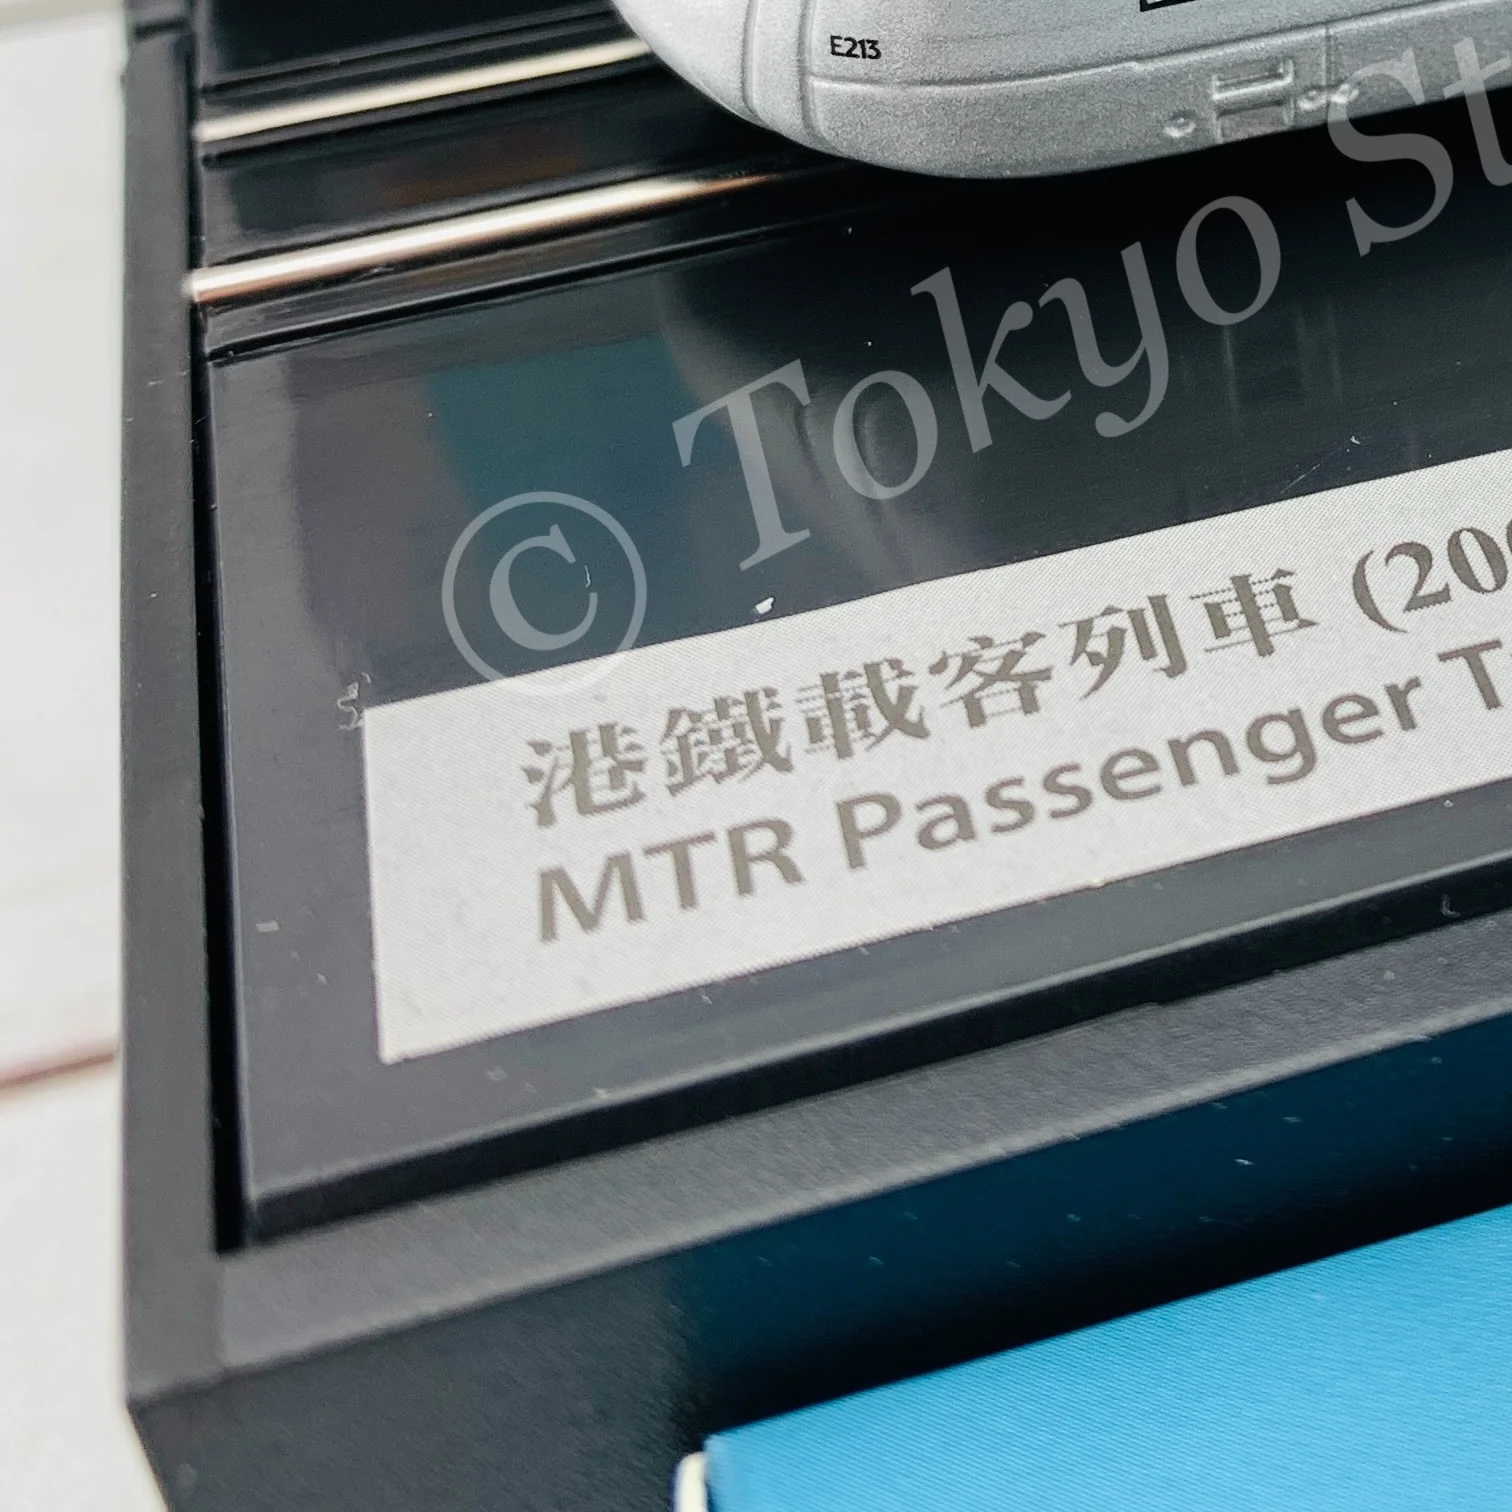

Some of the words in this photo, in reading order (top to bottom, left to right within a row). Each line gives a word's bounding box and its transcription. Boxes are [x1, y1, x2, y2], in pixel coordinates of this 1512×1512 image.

[830, 35, 882, 59] E213
[521, 567, 1320, 828] 港鐵載客列車
[536, 816, 806, 944] MTR
[835, 675, 1422, 871] Passenger
